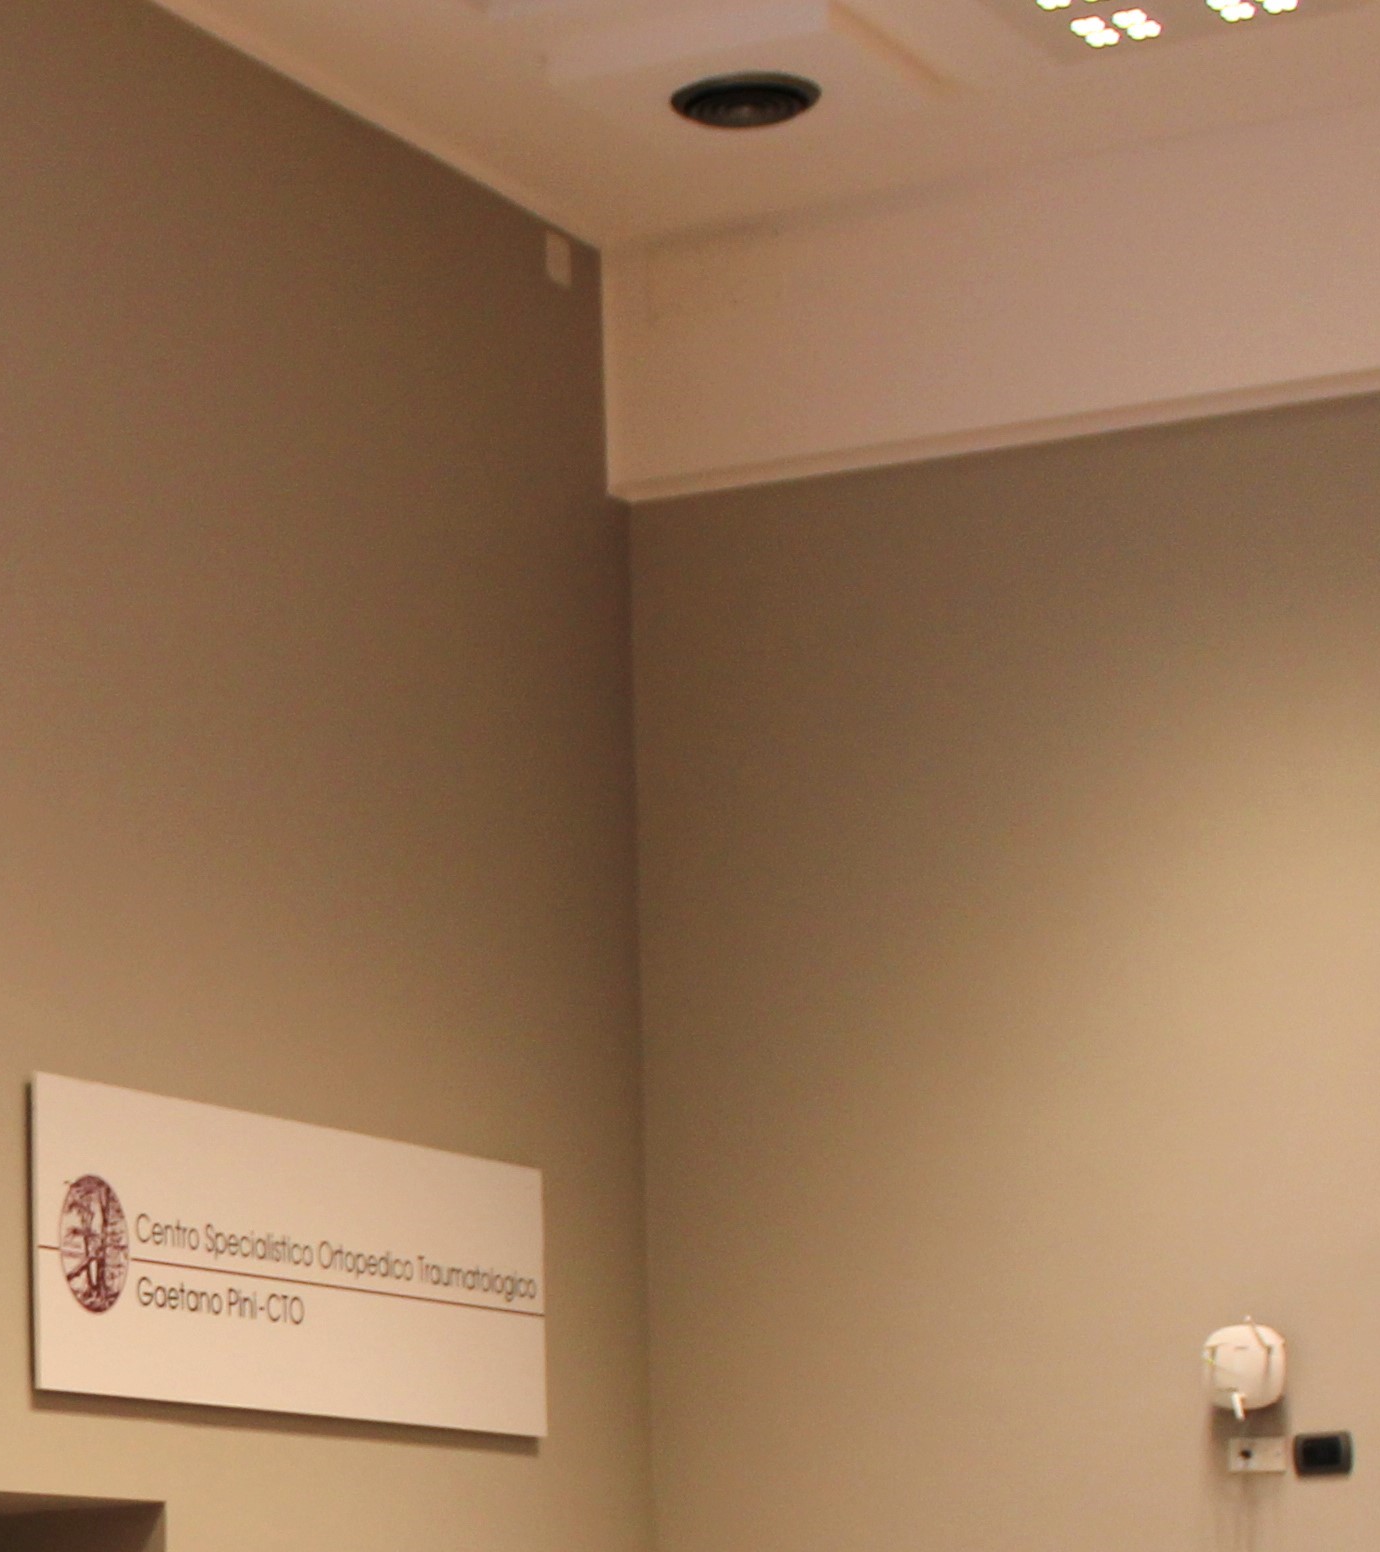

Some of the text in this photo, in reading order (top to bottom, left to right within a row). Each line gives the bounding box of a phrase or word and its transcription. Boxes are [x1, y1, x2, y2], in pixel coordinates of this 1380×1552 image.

[136, 1213, 537, 1302] Centro Specialistico Ortopedico Traumatologico
[136, 1276, 305, 1326] Gaetano Pini-CTO
